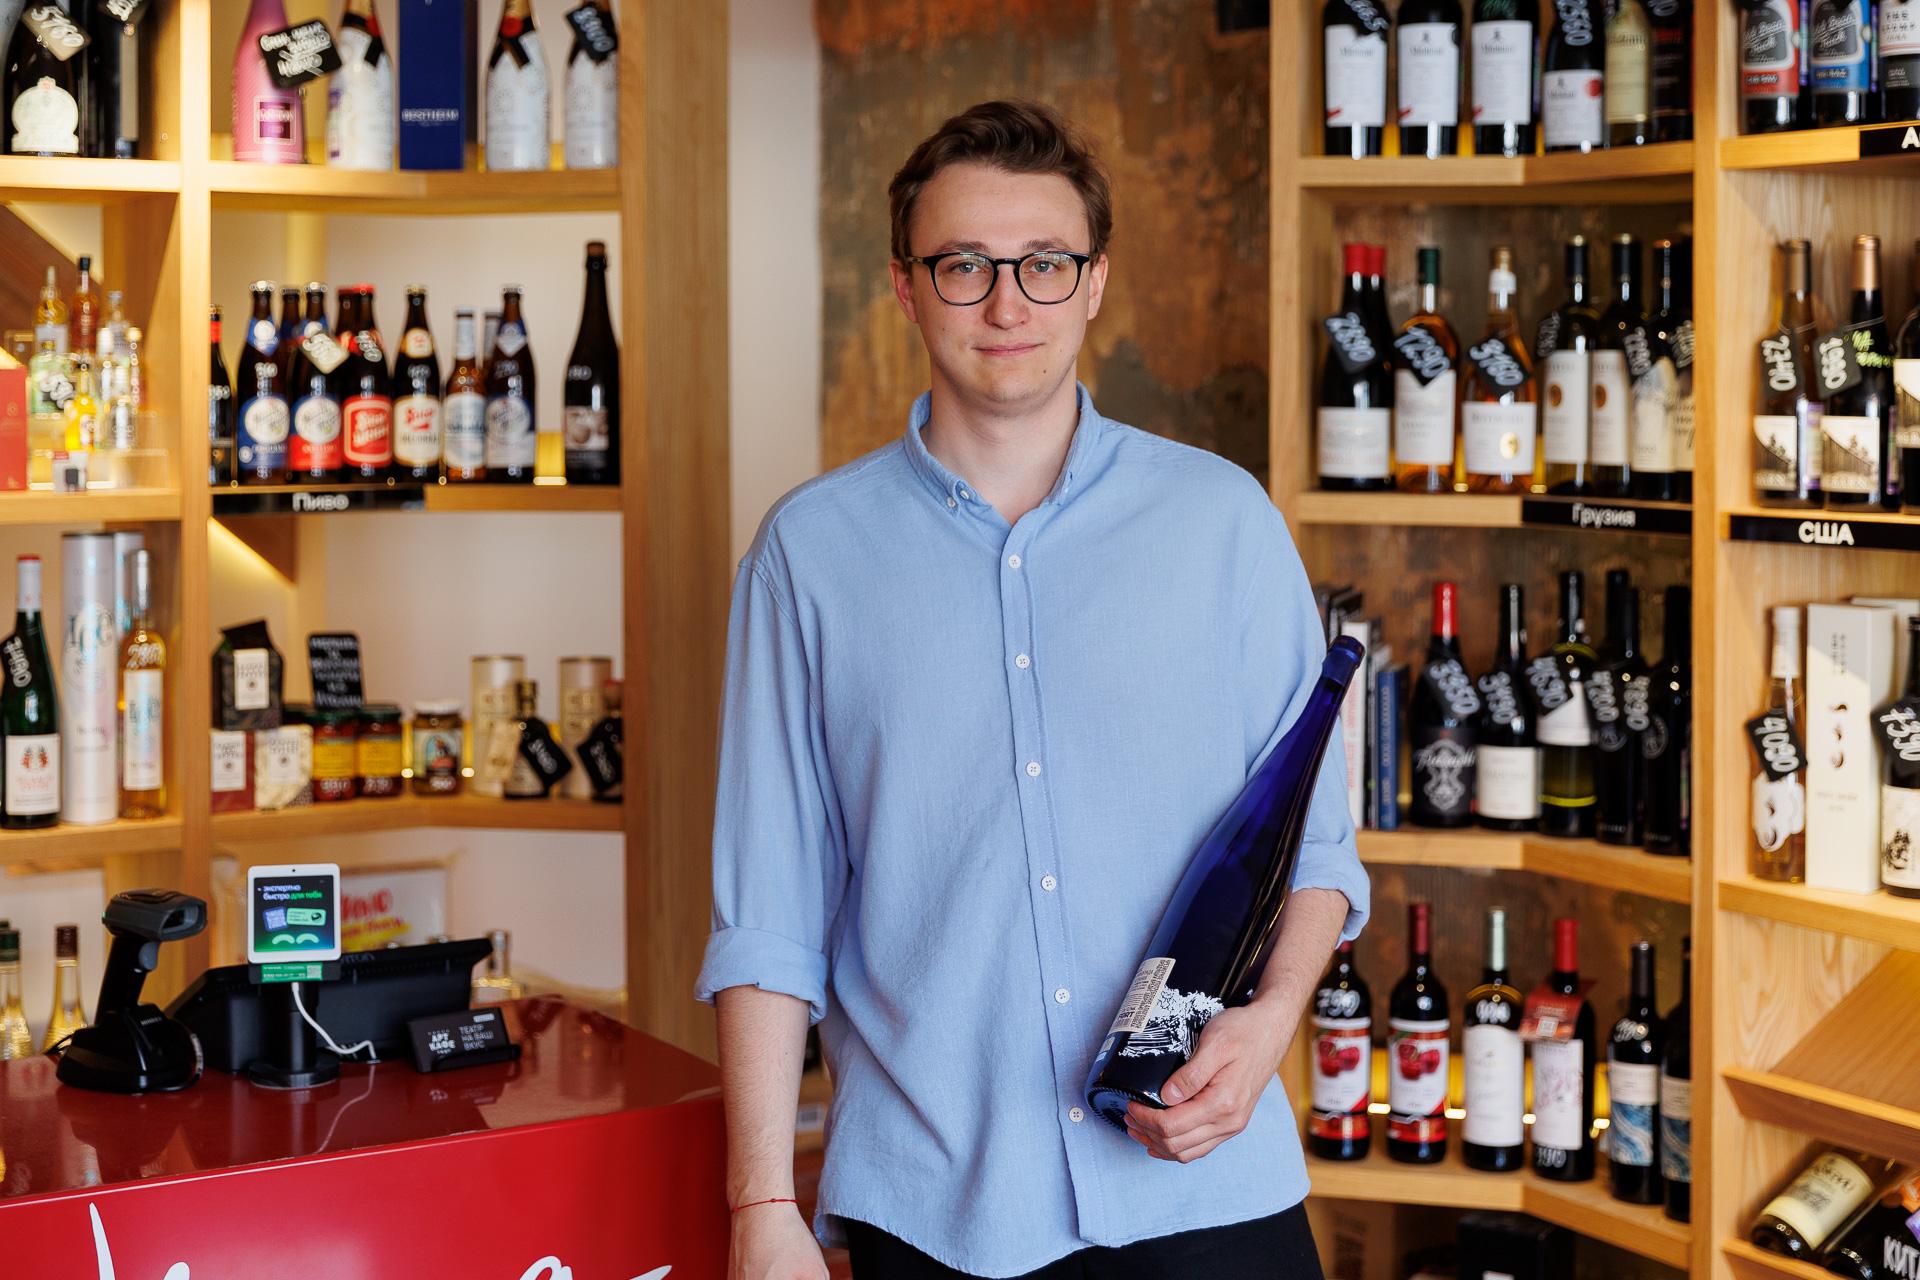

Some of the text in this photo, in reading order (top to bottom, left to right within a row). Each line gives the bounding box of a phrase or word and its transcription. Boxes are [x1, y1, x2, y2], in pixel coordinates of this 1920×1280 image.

[292, 492, 350, 512] Пиво
[1571, 503, 1636, 528] Грузия
[1799, 521, 1855, 546] США
[263, 884, 302, 893] экспертно
[263, 892, 290, 901] быстро
[305, 890, 322, 899] тебя
[431, 1032, 449, 1042] АРТ
[428, 1039, 456, 1052] КАФЕ
[1883, 1235, 1920, 1280] КИТ
